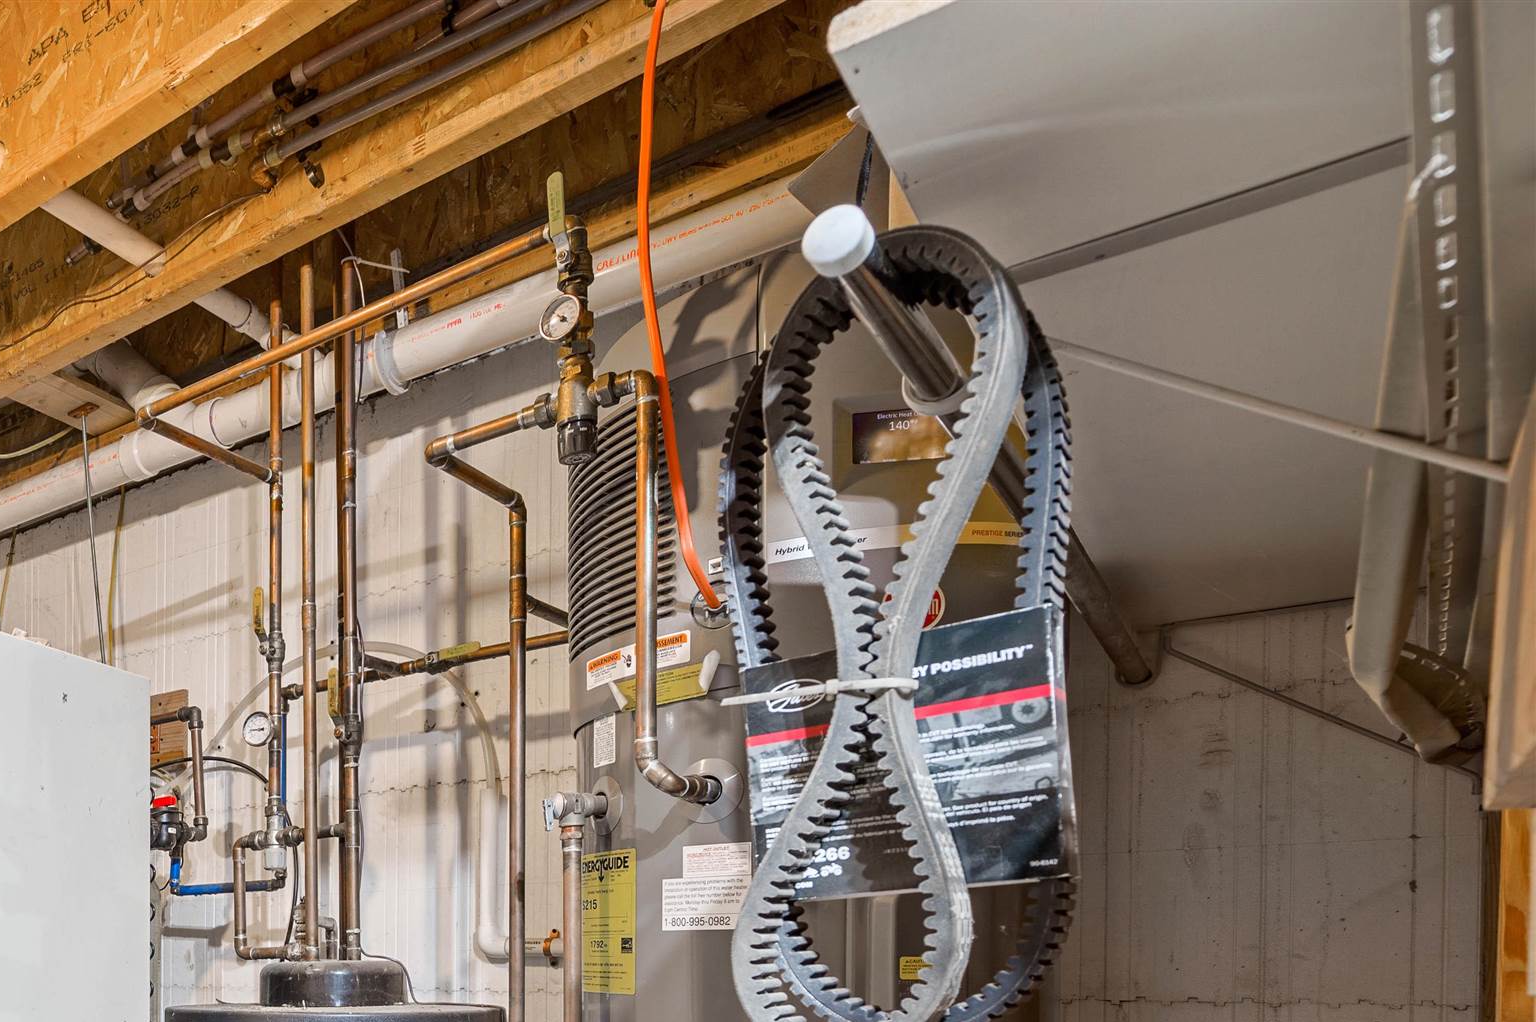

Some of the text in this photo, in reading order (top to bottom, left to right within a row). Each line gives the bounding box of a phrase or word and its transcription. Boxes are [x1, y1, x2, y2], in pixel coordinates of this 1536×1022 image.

[27, 27, 69, 66] APA
[877, 412, 898, 420] Electric
[898, 411, 913, 419] Heat
[971, 529, 1004, 537] PRESTIGE
[775, 544, 805, 556] Hybrid
[664, 916, 731, 927] 1-800-995-0982
[590, 940, 604, 949] 1792
